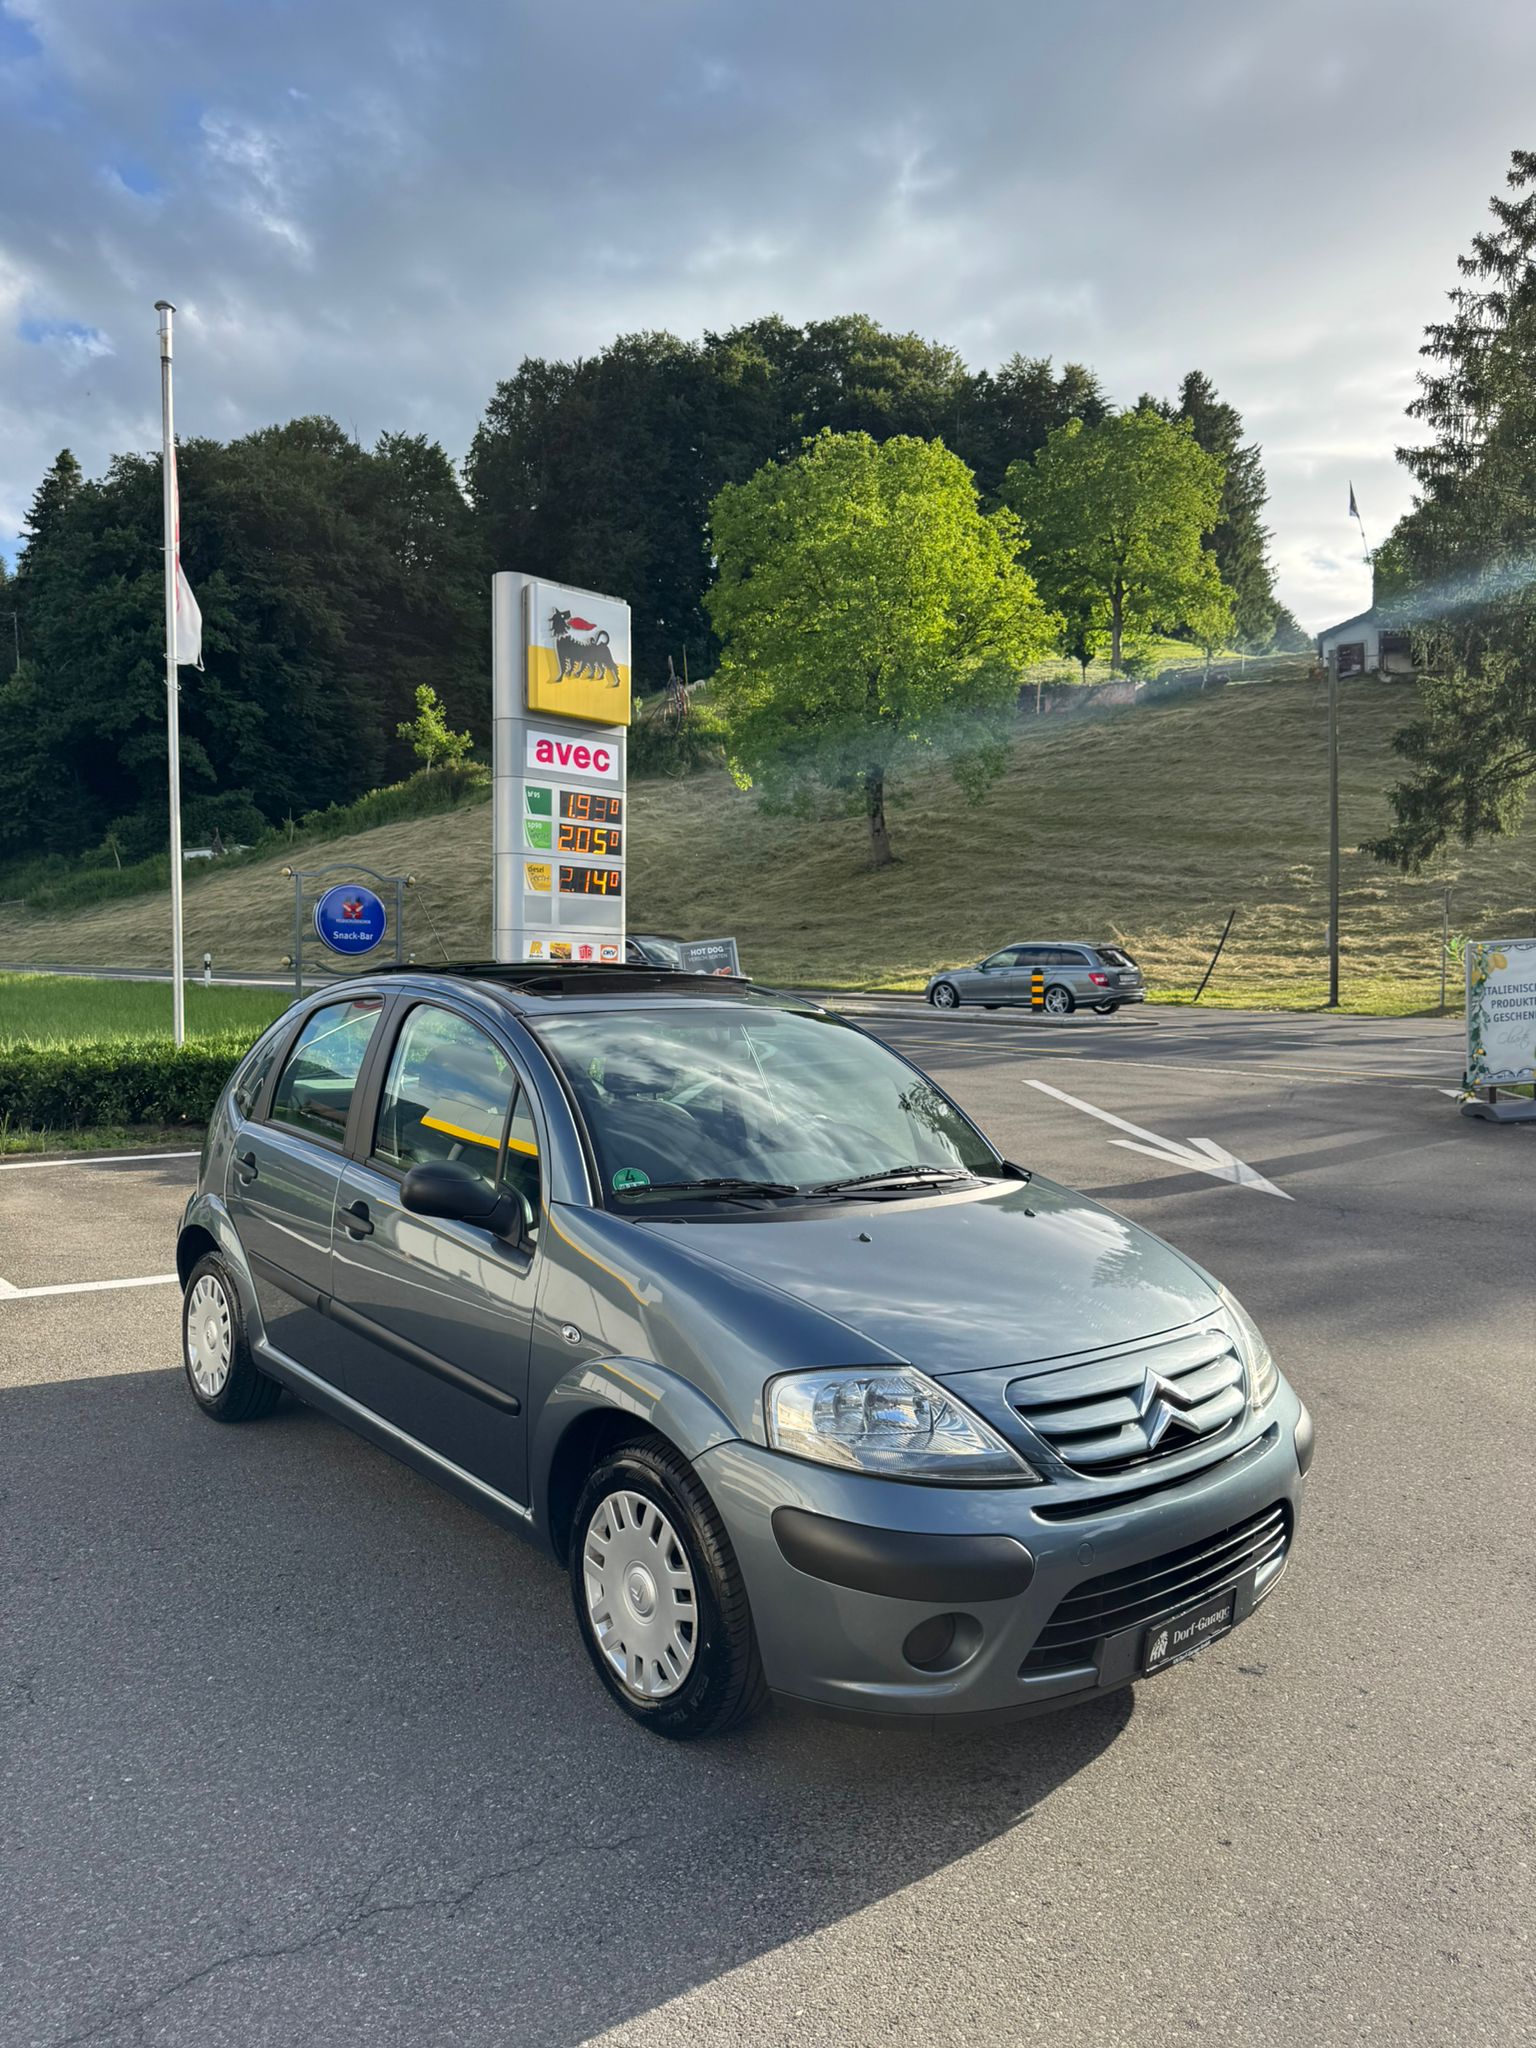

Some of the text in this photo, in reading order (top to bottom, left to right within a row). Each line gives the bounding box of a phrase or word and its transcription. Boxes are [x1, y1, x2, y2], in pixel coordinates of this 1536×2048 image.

[536, 739, 610, 772] avec
[333, 931, 374, 940] Snack-Bar
[690, 945, 724, 956] HOT DOG
[625, 1169, 636, 1182] 4
[1173, 1606, 1230, 1645] Dorf-Garage
